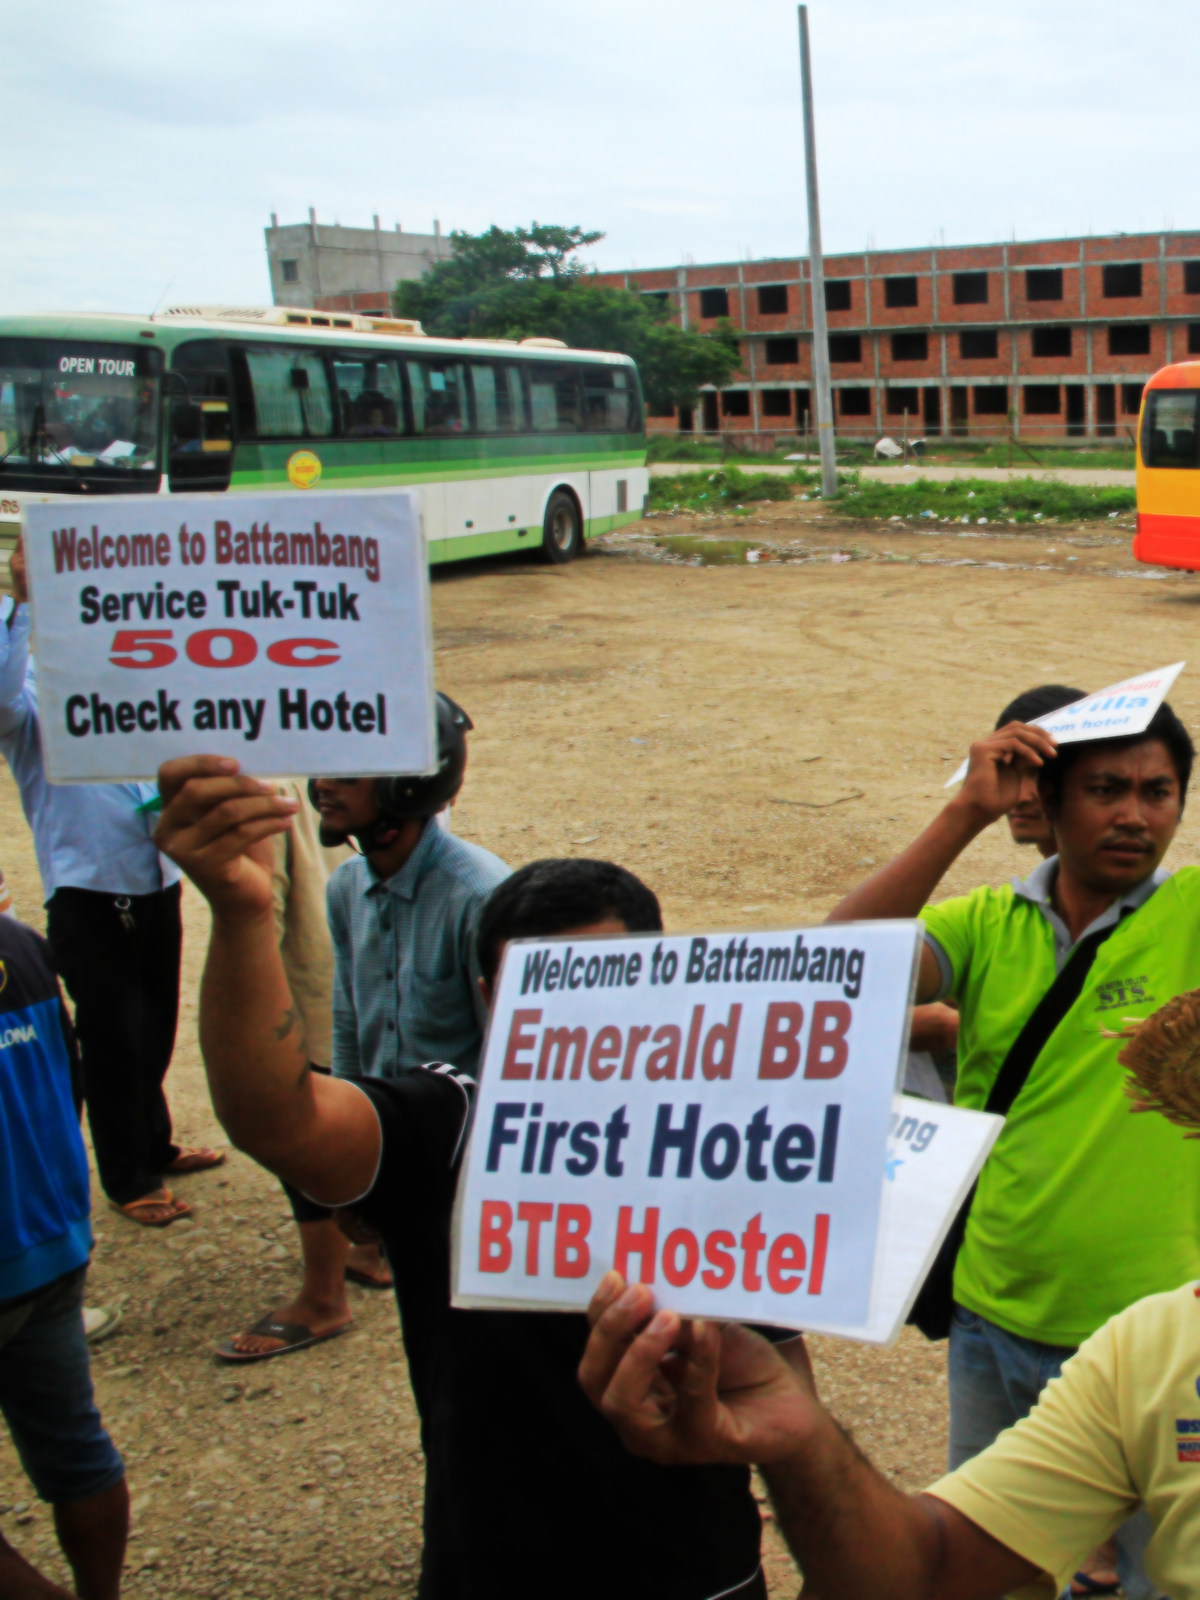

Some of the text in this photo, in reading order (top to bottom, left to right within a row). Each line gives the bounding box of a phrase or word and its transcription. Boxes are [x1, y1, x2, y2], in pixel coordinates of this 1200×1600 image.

[60, 357, 135, 376] OPEN TOUR
[52, 520, 380, 583] Welcome to Battambang
[80, 580, 360, 624] Service Tuk-Tuk
[108, 628, 341, 669] 50c
[65, 688, 387, 741] Check any Hotel
[1082, 716, 1130, 729] hotel
[521, 934, 865, 999] Welcome to Battambang
[1099, 984, 1145, 1004] STS
[500, 1000, 852, 1081] Emerald BB
[485, 1102, 629, 1177] First
[648, 1103, 841, 1183] Hotel
[478, 1200, 830, 1295] BTB Hostel
